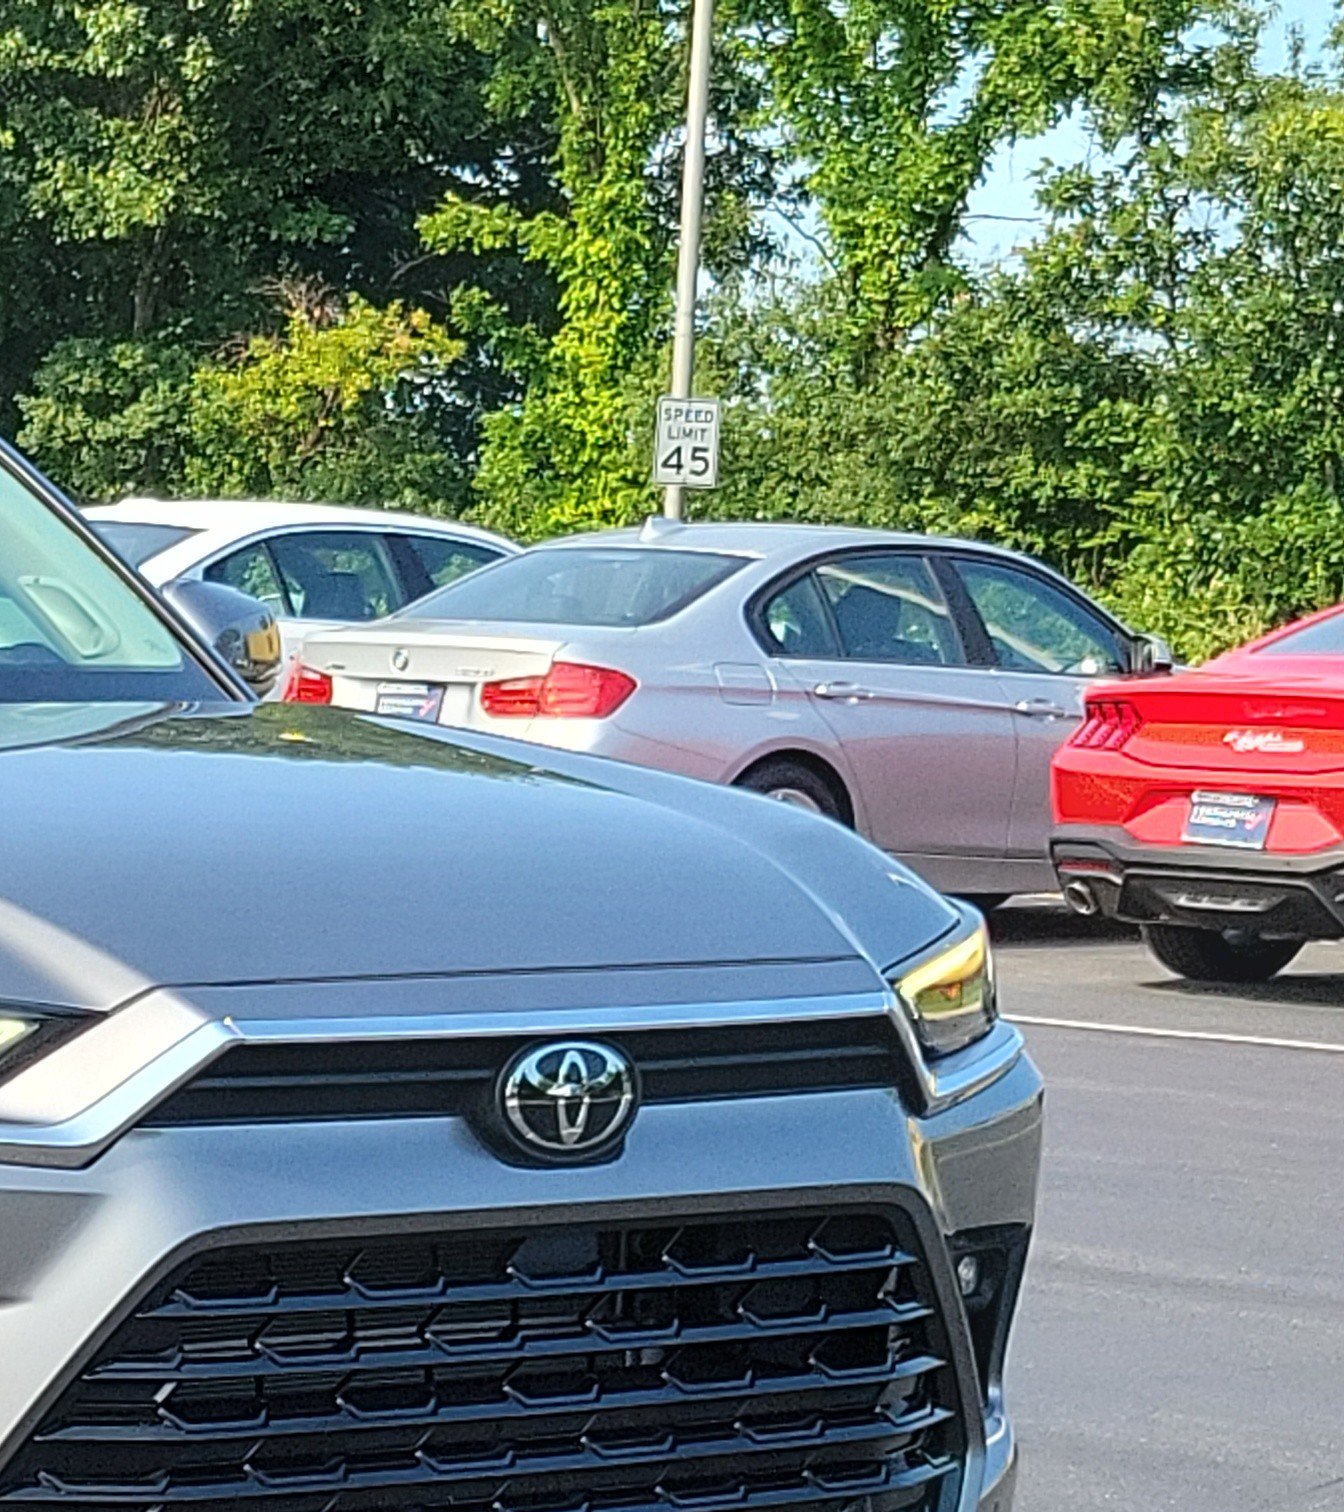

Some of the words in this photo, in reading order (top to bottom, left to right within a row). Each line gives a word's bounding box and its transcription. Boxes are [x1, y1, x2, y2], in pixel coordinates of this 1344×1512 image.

[664, 407, 714, 424] SPEED
[667, 426, 708, 442] LIMIT
[661, 445, 710, 477] 45
